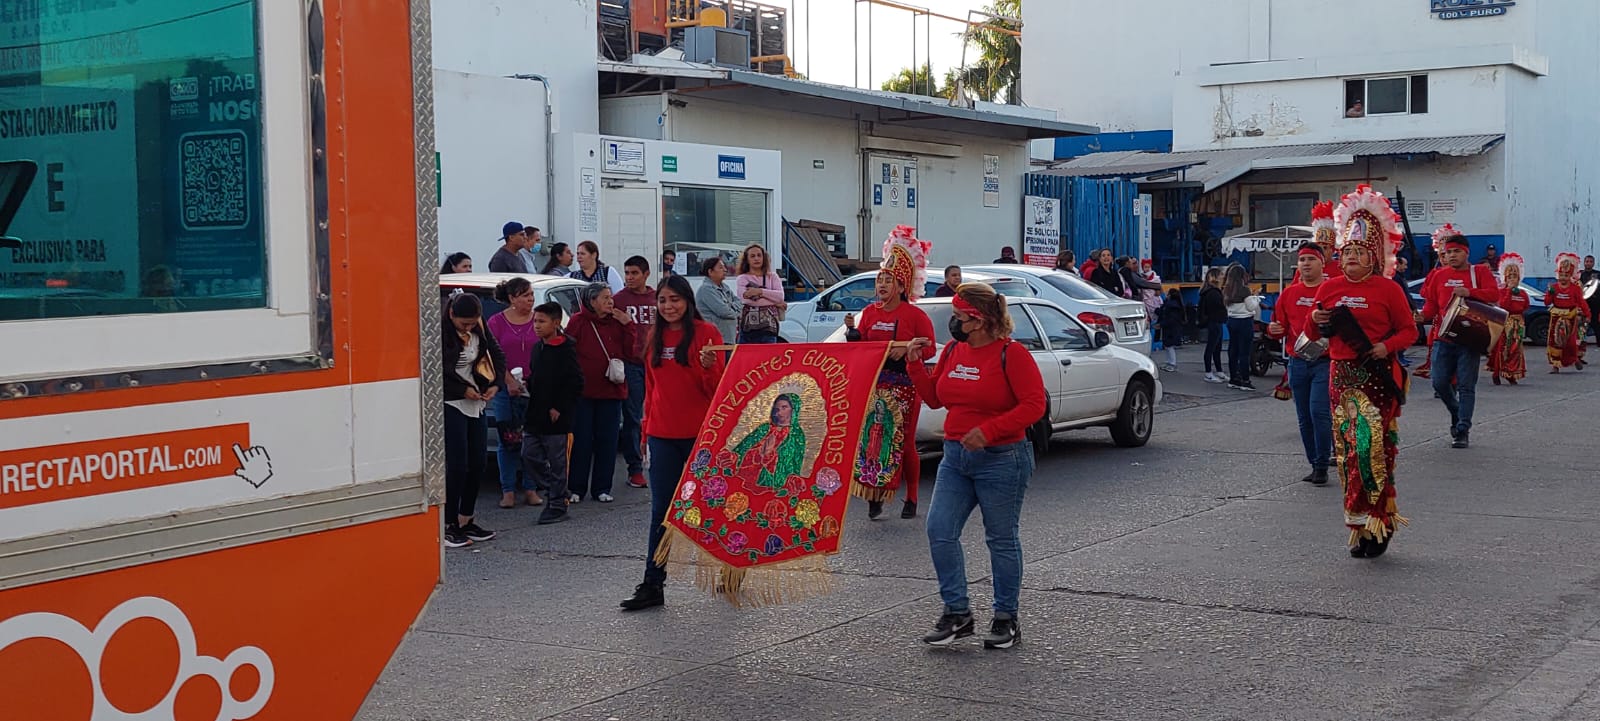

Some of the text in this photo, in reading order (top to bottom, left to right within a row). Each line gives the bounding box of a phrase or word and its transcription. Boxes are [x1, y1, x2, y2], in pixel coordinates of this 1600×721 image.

[1470, 8, 1502, 16] PURO
[720, 160, 744, 174] OFICINA
[47, 163, 65, 213] E
[0, 445, 222, 495] RECTAPORTAL.COM
